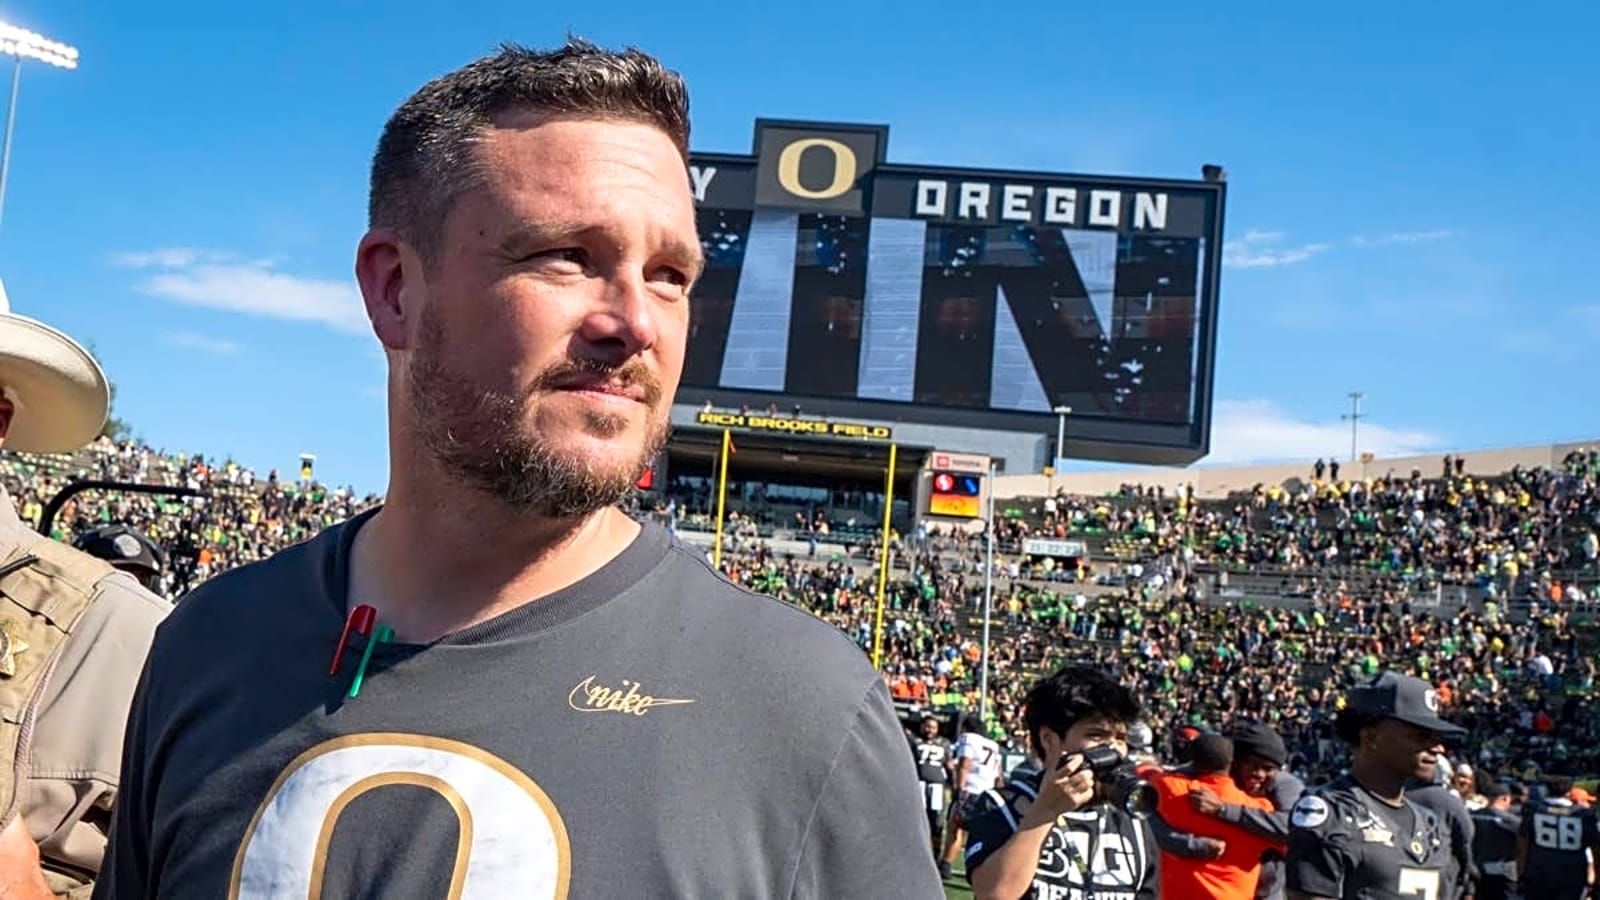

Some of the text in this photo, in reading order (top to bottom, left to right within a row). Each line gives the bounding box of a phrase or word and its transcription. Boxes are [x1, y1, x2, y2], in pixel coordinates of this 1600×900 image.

[778, 138, 857, 199] O
[915, 179, 1168, 230] OREGON
[699, 413, 890, 438] RICH BROOKS FIELD
[588, 679, 655, 716] nike
[917, 743, 945, 767] 72
[1533, 813, 1583, 851] 68
